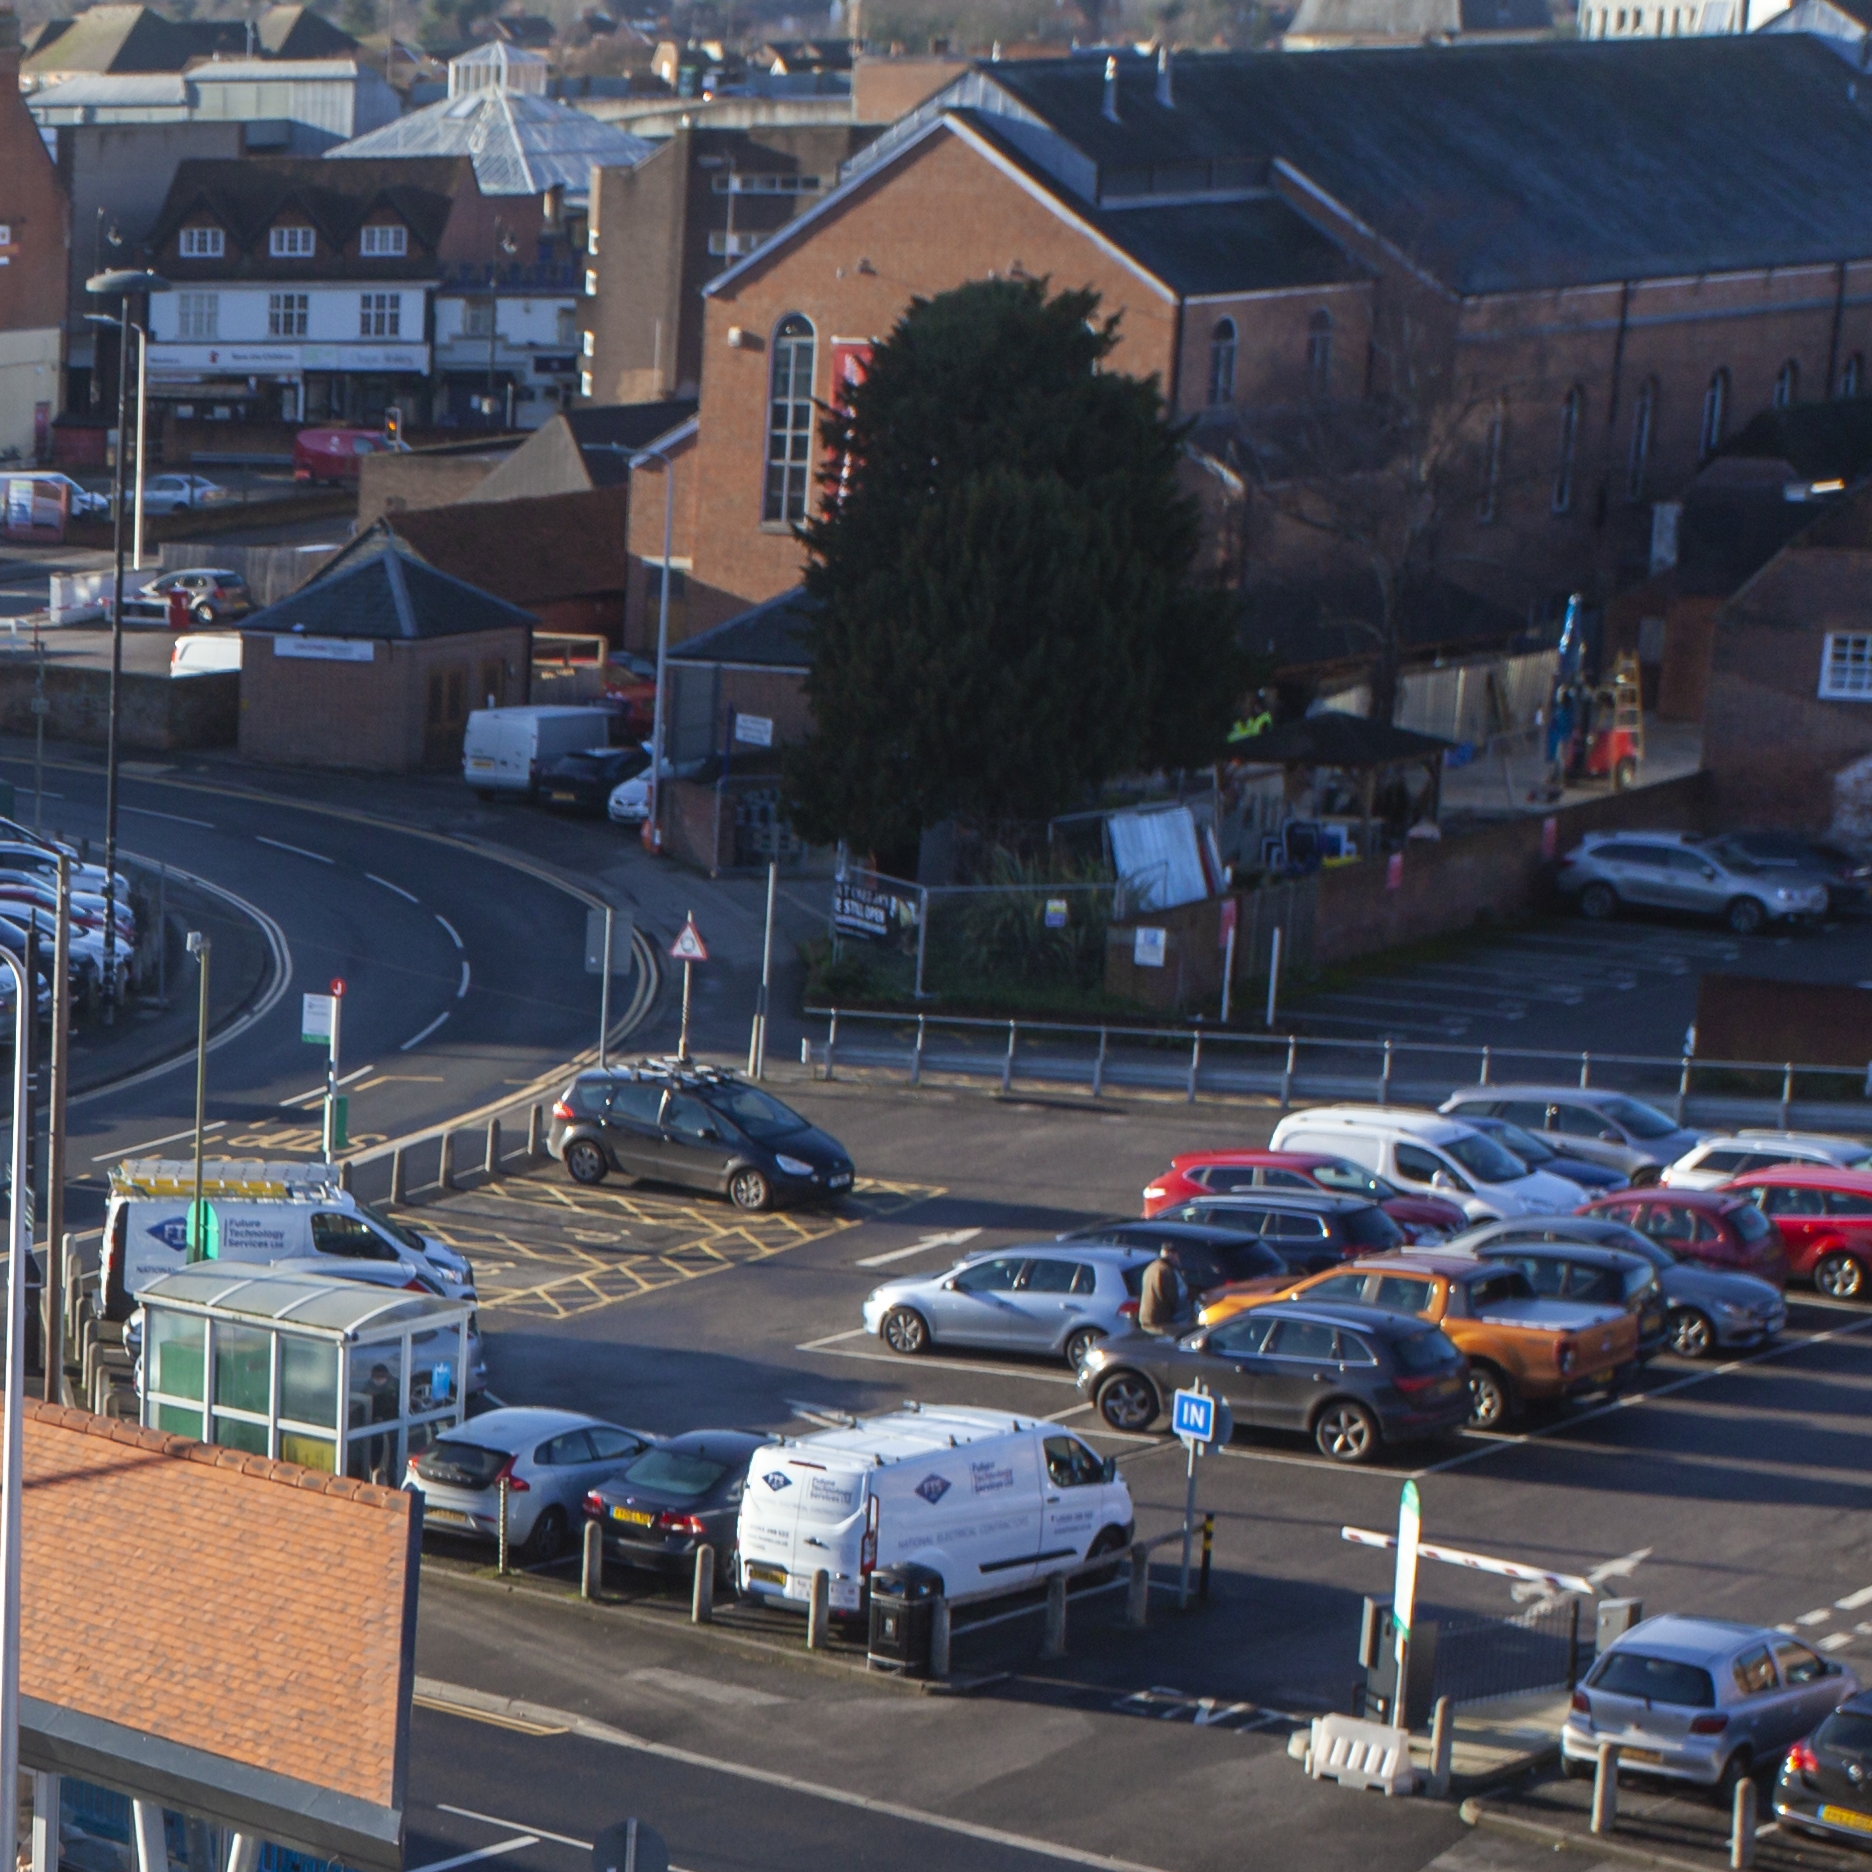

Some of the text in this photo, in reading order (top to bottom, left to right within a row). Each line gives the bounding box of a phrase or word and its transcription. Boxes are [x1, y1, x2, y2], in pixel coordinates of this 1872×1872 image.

[333, 981, 343, 996] J
[228, 1217, 262, 1229] Future
[228, 1228, 286, 1242] Technology
[227, 1238, 269, 1250] Services
[1182, 1400, 1206, 1430] IN
